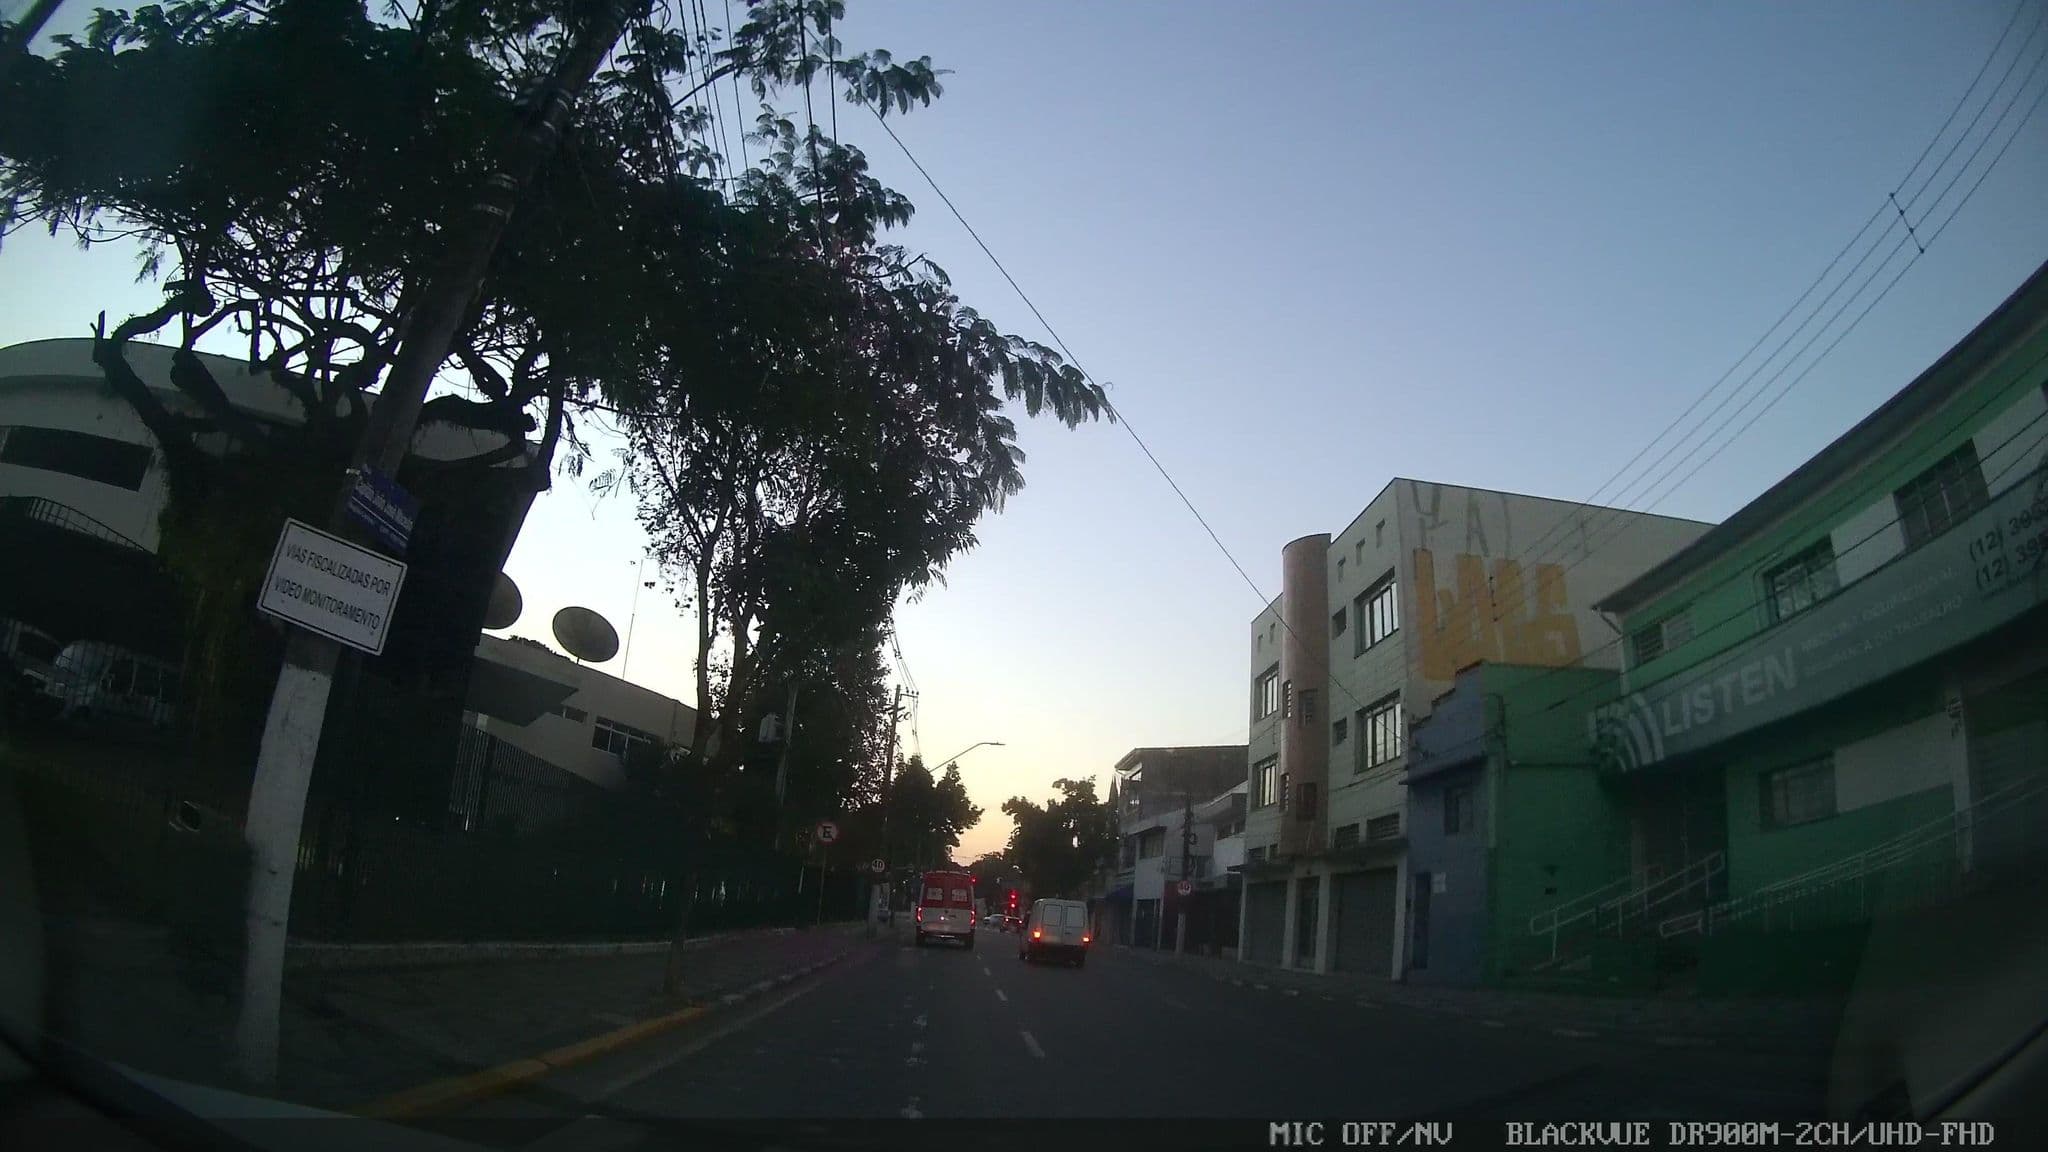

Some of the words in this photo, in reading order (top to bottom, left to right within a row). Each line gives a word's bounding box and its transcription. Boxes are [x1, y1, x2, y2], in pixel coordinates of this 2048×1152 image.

[1969, 524, 2004, 563] (12)
[287, 544, 307, 565] VIAS
[306, 551, 371, 590] FISCALIZADAS
[370, 576, 392, 597] POR
[1975, 553, 2010, 591] (12)
[274, 575, 303, 600] VIDEO
[301, 586, 381, 630] MONITORAMENTO
[1661, 646, 1799, 737] LISTEN
